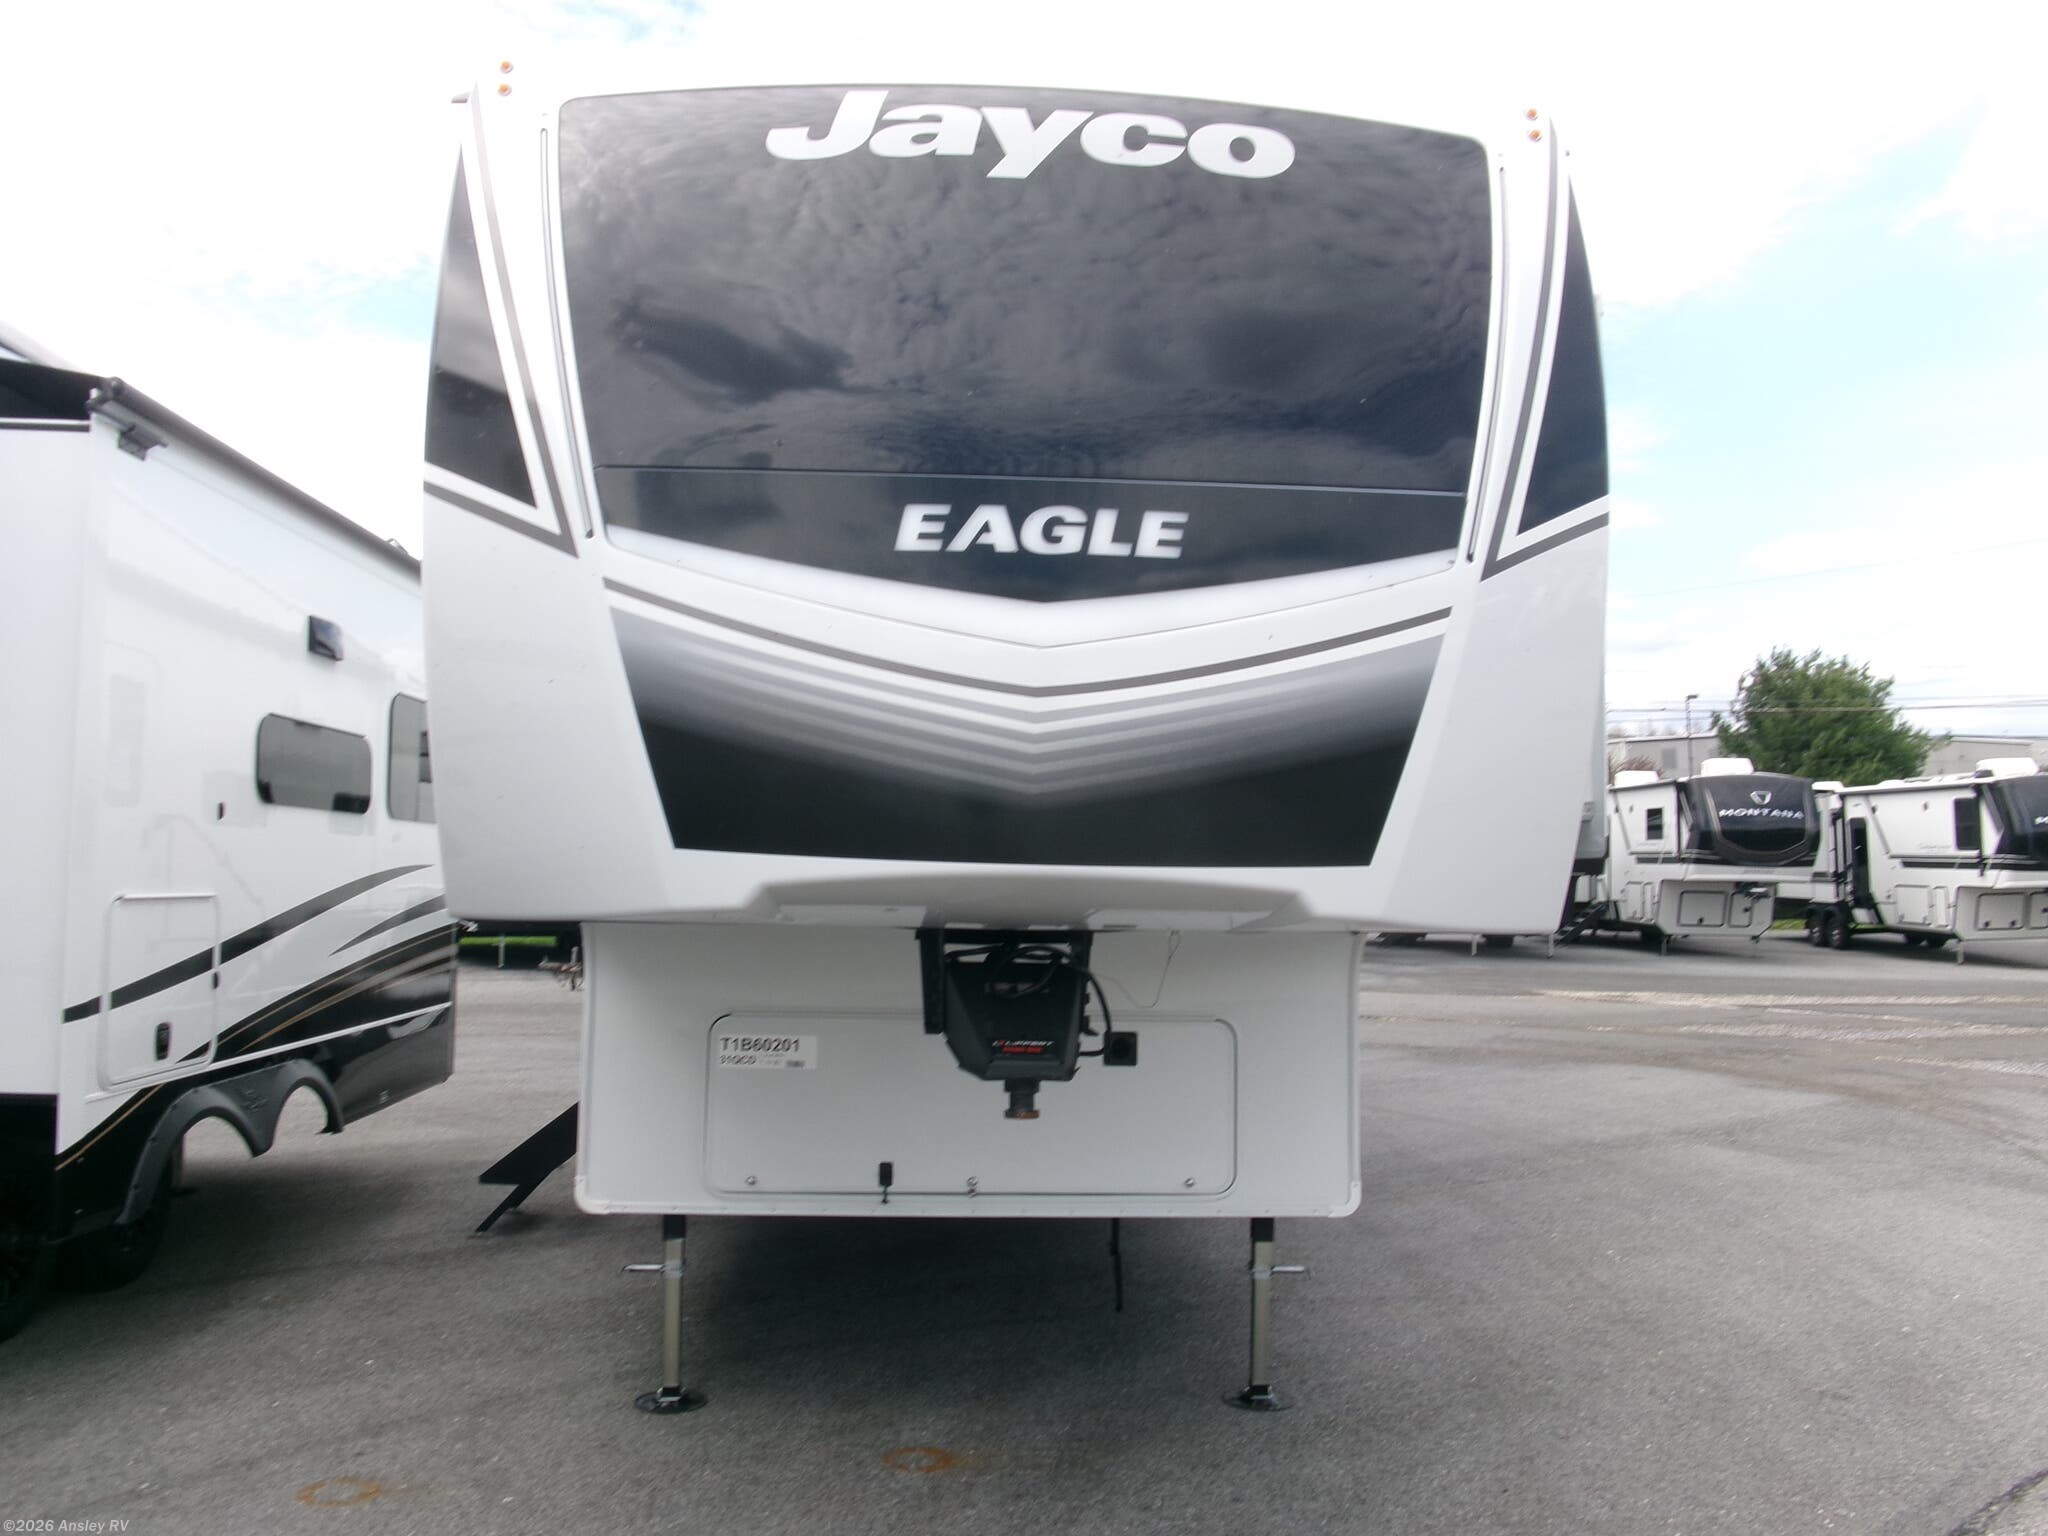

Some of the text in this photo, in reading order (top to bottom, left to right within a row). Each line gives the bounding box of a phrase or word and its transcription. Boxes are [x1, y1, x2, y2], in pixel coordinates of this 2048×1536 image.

[765, 89, 1296, 180] Jayco
[894, 503, 1190, 559] EAGLE
[1718, 808, 1805, 820] MONTANA
